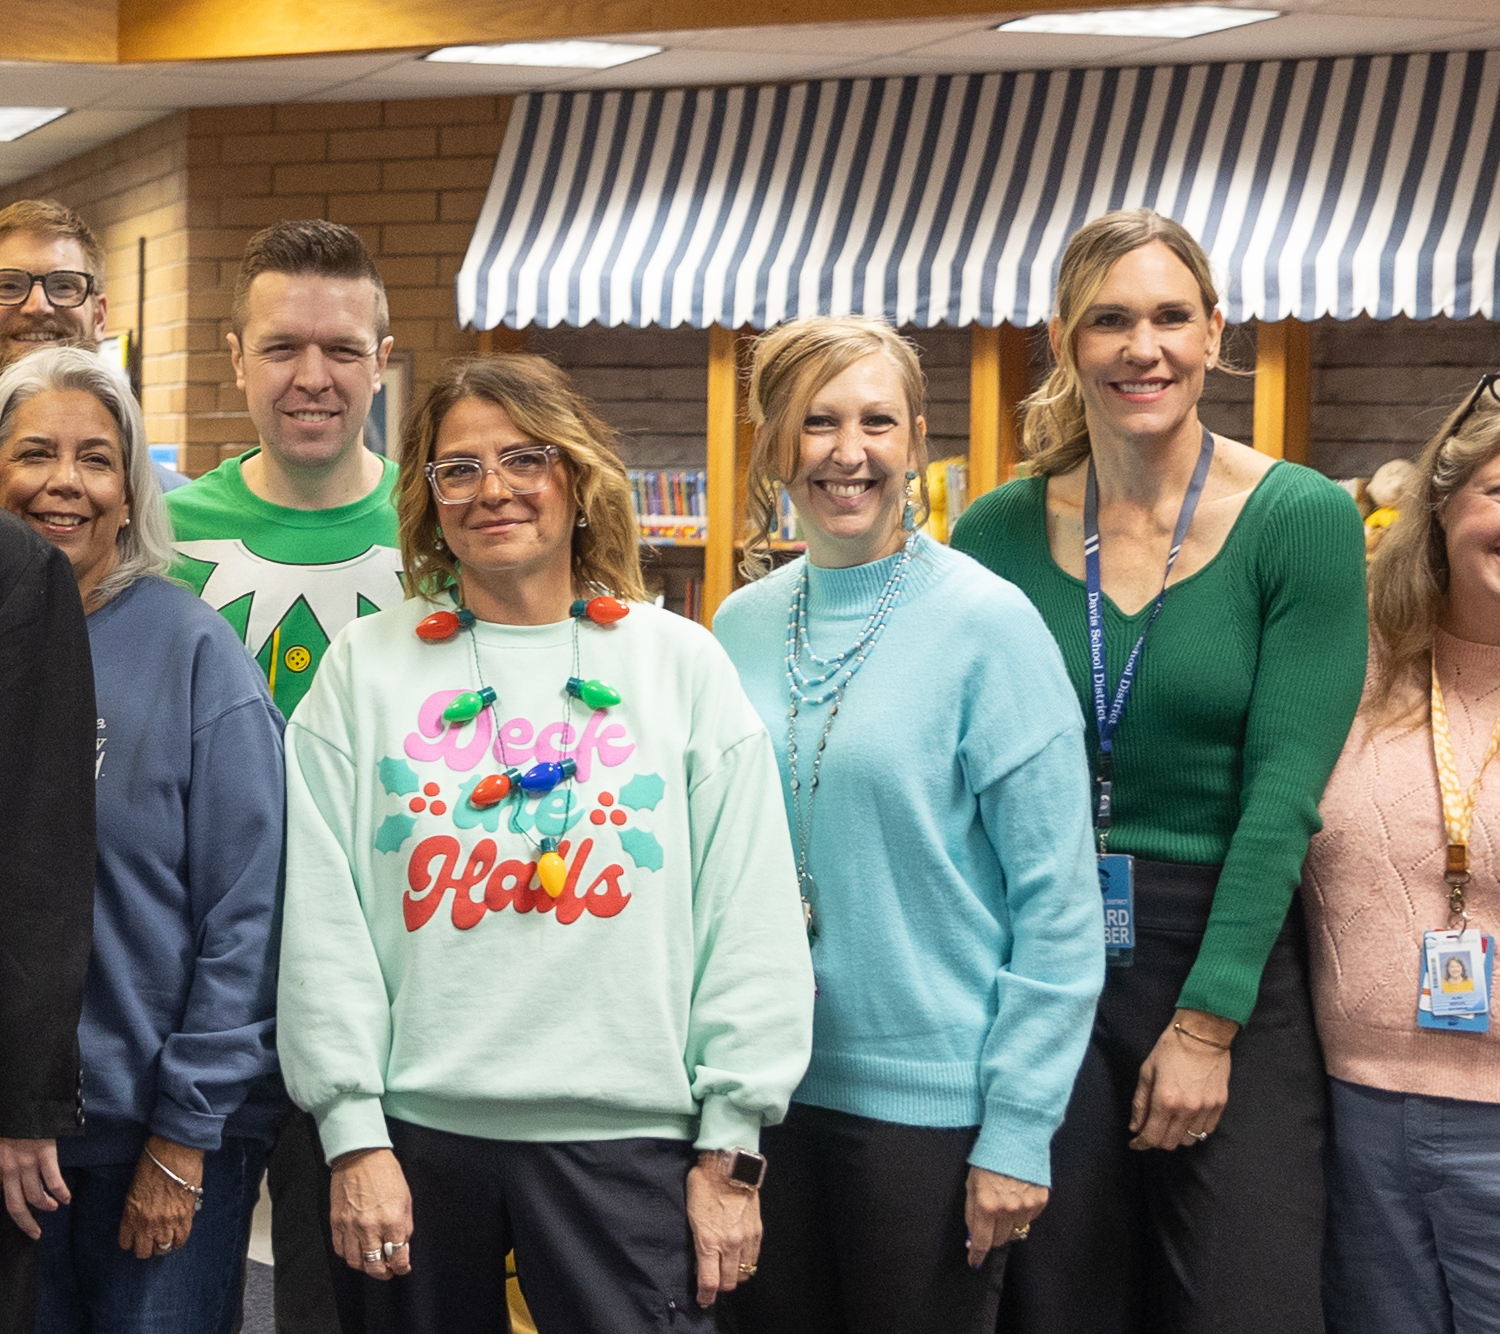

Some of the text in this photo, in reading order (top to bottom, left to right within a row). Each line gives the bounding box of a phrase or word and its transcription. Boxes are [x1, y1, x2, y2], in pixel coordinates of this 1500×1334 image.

[1088, 591, 1107, 722] Davis School District
[1108, 678, 1131, 725] District
[403, 689, 637, 784] Deck
